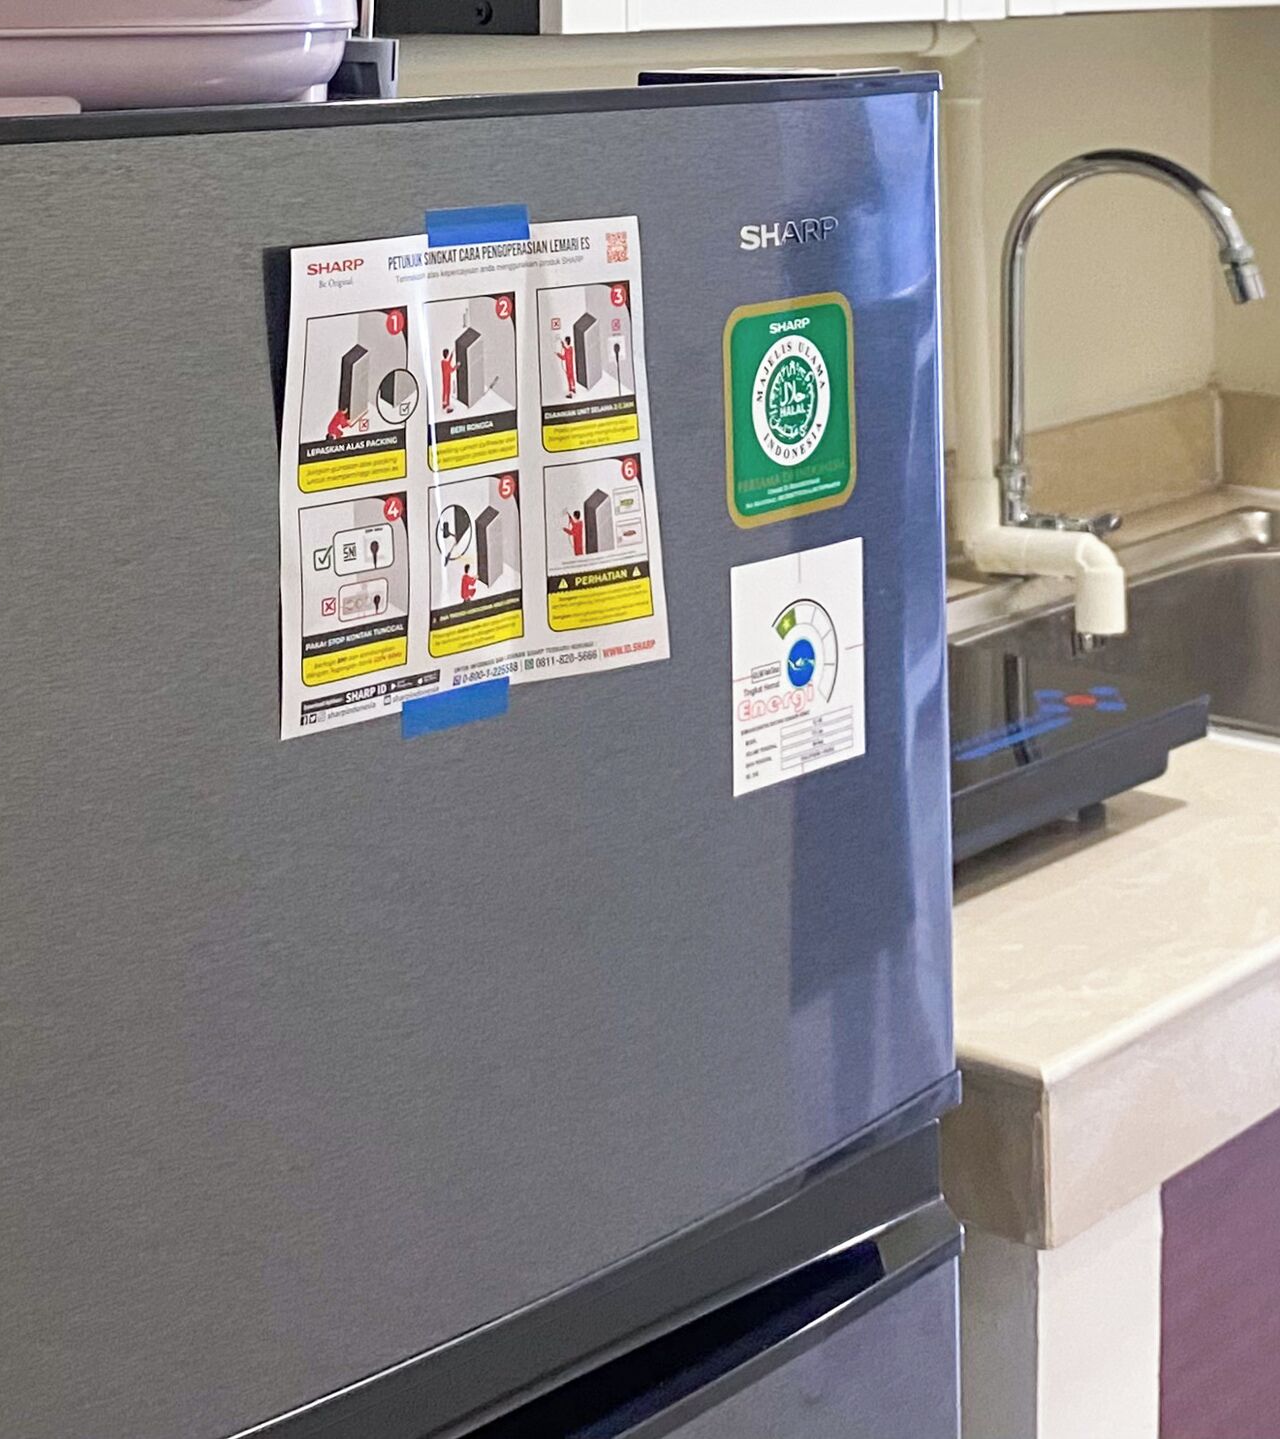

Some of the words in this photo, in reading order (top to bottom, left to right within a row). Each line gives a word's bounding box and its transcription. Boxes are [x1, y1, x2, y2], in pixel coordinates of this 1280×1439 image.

[739, 216, 839, 251] SHARP
[387, 253, 423, 271] PETUNJUK
[423, 249, 457, 266] SINGKAT
[458, 247, 481, 262] CARA
[481, 241, 548, 260] PENGOPERASIAN
[580, 237, 591, 250] ES
[306, 258, 364, 276] SHARP
[612, 287, 625, 305] 3
[497, 299, 510, 319] 2
[769, 317, 811, 335] SHARP
[756, 341, 793, 403] MAJELIS
[798, 341, 826, 389] ULAMA
[780, 405, 807, 418] HALAL
[306, 444, 345, 457] LEPASKAN
[346, 441, 365, 450] ALAS
[366, 436, 398, 448] PACKING
[763, 422, 823, 461] INDONESIA
[625, 461, 635, 479] 6
[502, 479, 514, 498] 5
[387, 502, 400, 519] 4
[574, 569, 628, 586] PERHATIAN
[345, 686, 376, 704] SHARP
[377, 684, 388, 695] ID
[737, 683, 815, 722] Energi
